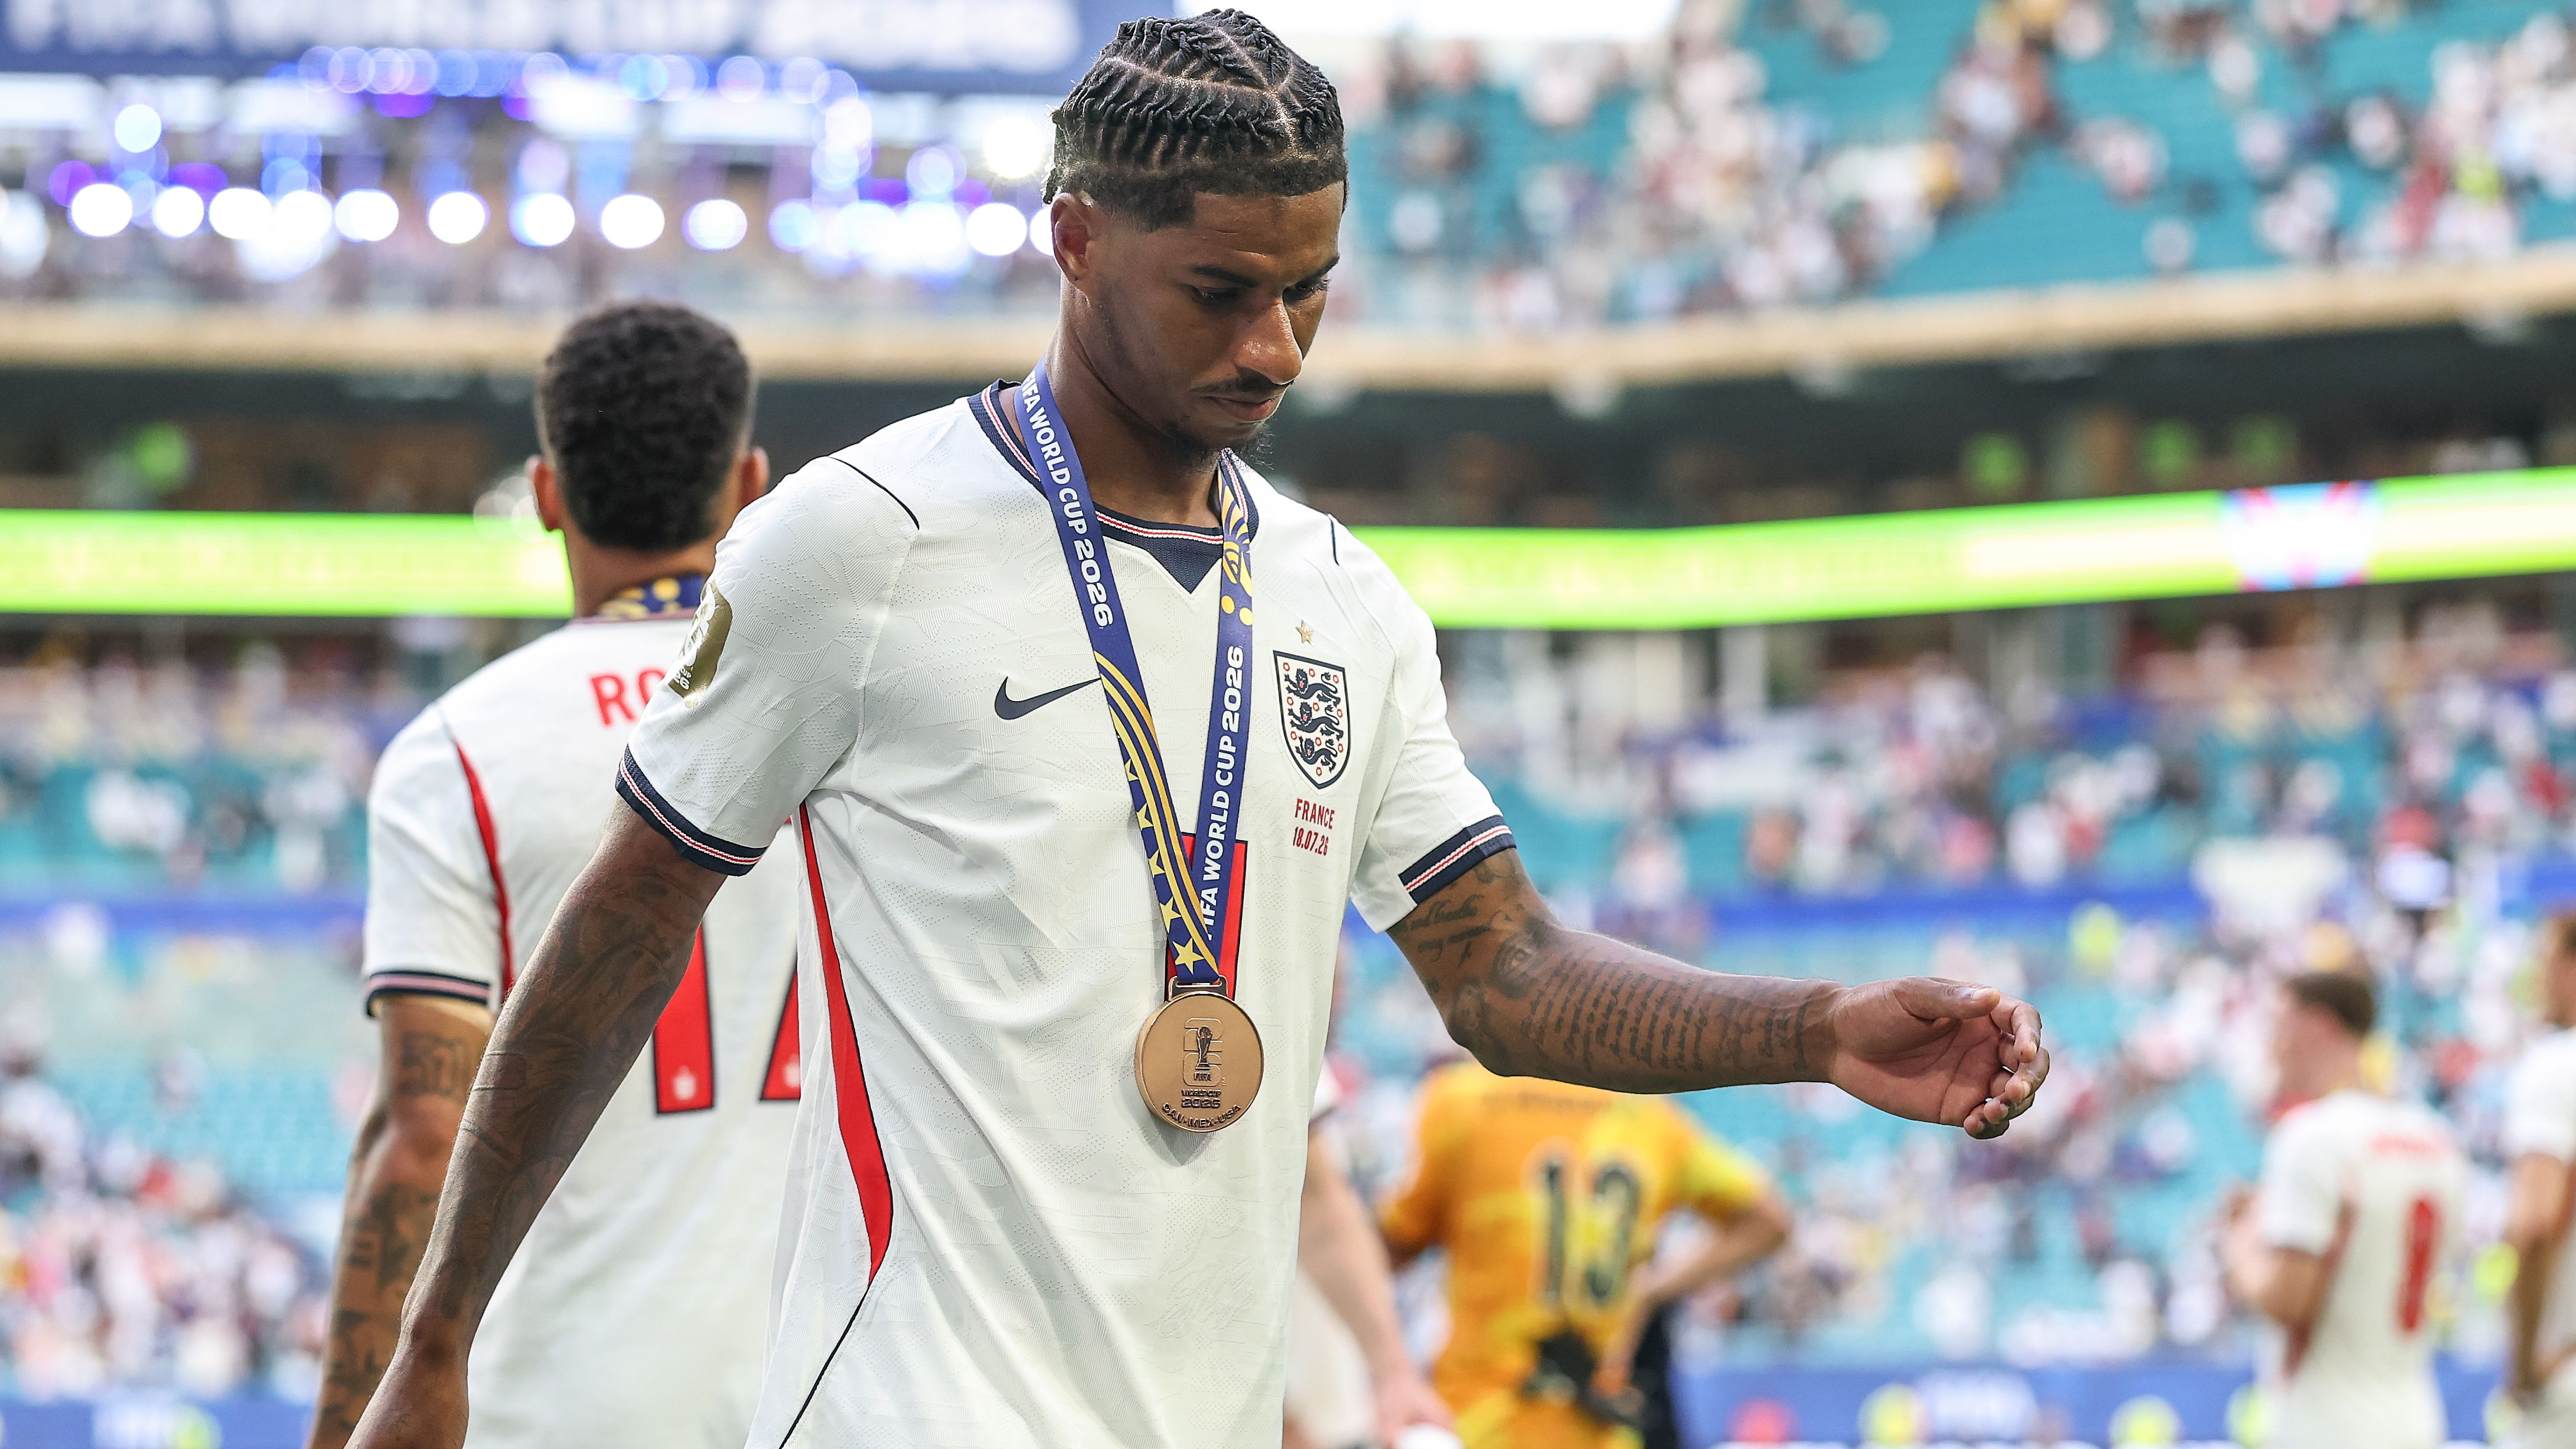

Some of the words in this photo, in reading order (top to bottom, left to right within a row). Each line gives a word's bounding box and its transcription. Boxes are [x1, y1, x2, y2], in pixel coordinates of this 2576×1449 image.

[1029, 407, 1071, 485] WORLD
[1059, 488, 1086, 535] CUP
[1073, 540, 1115, 628] 2026
[1222, 645, 1244, 733] 2026
[1215, 735, 1237, 787] CUP
[1202, 787, 1231, 883] WORLD
[1294, 797, 1335, 830] FRANCE
[1293, 826, 1329, 857] 18.07.26
[1200, 887, 1219, 941] IFA
[1181, 1097, 1221, 1108] 2026
[1194, 1072, 1212, 1082] FIFA
